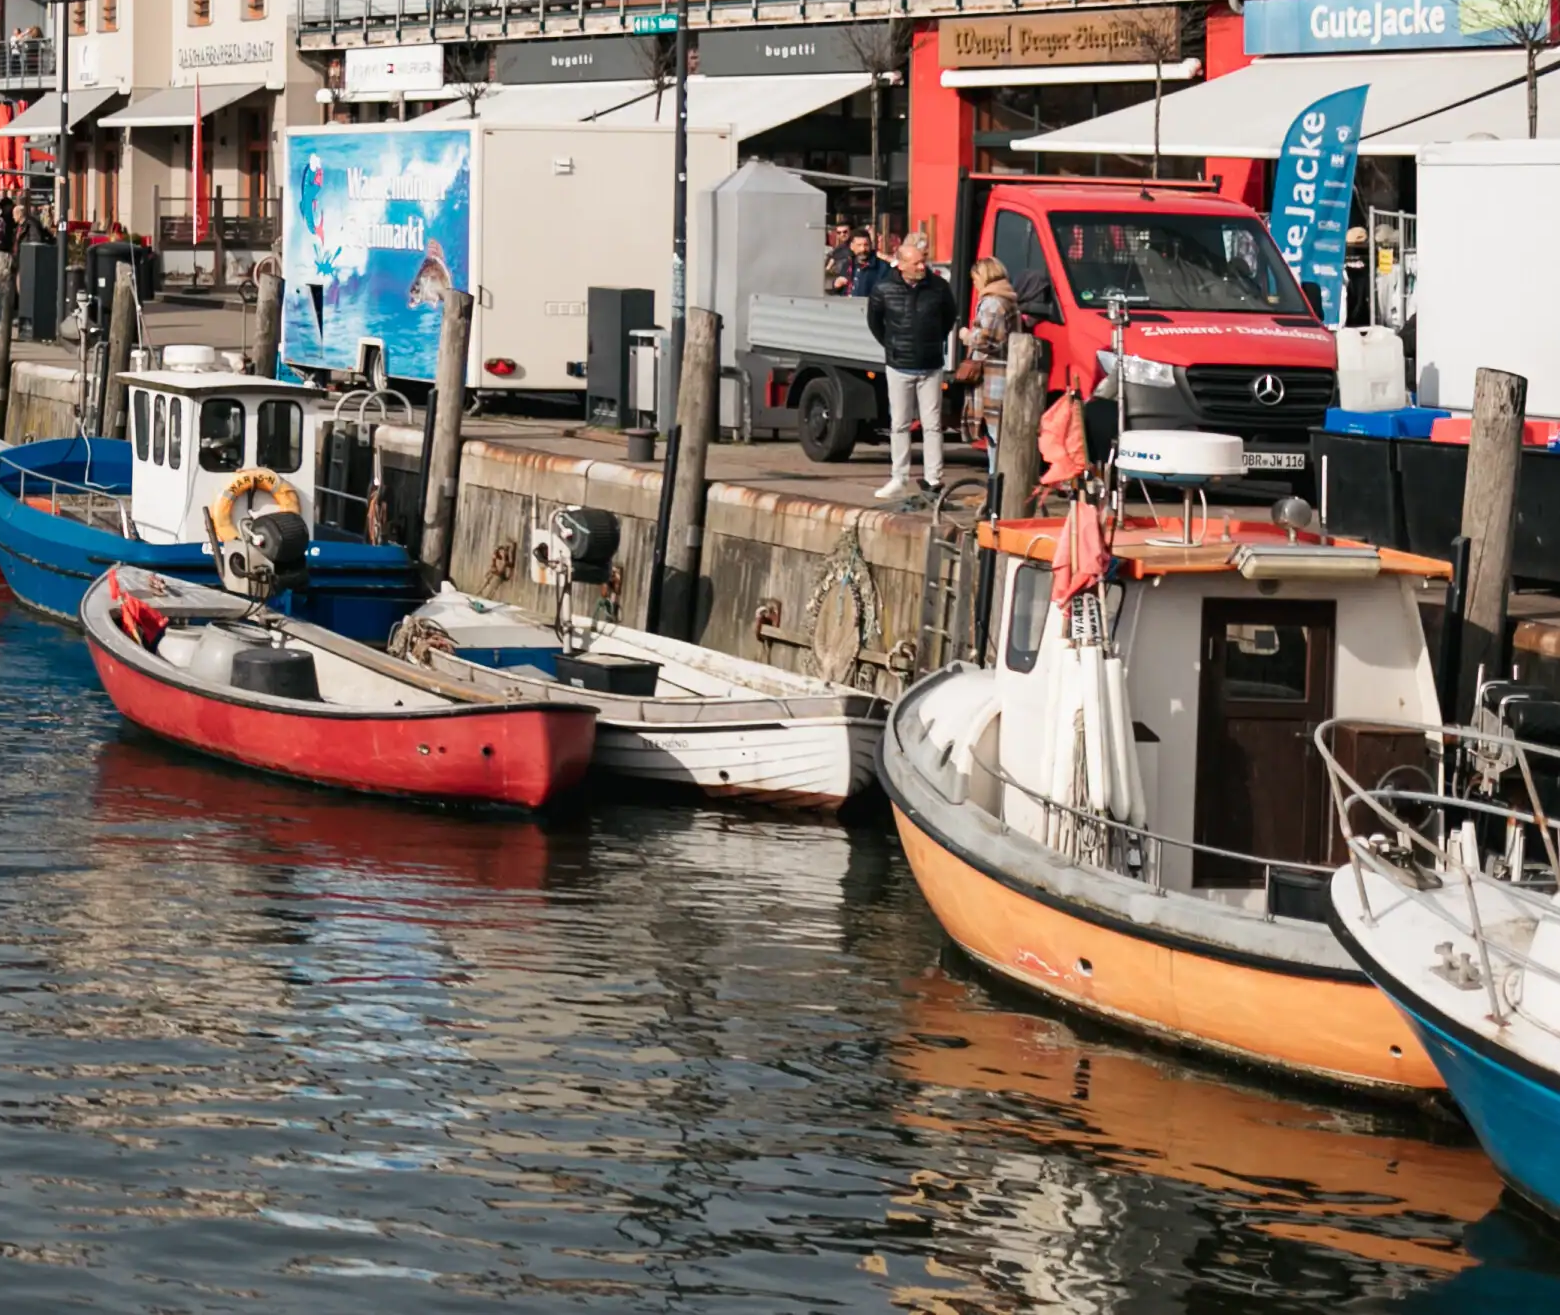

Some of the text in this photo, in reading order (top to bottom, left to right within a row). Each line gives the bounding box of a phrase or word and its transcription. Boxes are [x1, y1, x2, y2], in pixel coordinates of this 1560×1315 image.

[765, 43, 816, 58] bugatti
[551, 54, 593, 67] bugatti
[1285, 455, 1304, 468] 116
